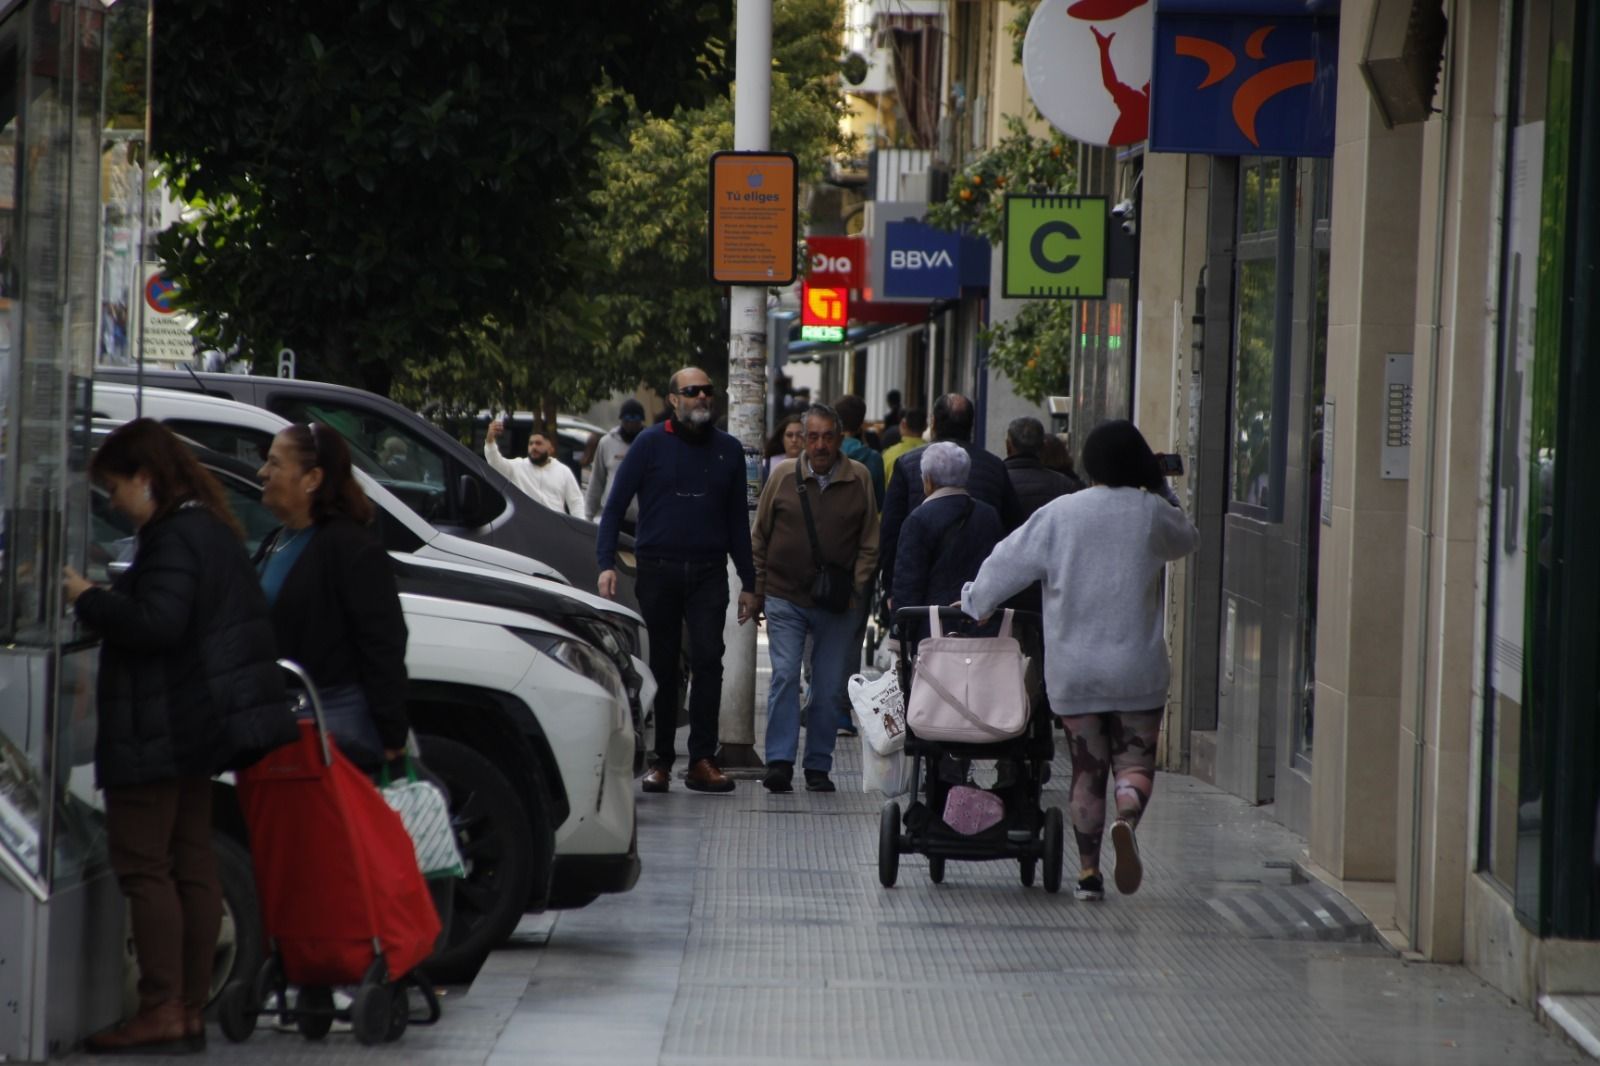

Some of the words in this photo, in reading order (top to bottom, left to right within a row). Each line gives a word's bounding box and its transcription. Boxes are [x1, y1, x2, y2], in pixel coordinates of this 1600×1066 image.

[743, 191, 779, 203] eliges
[1030, 220, 1082, 274] C
[891, 250, 953, 269] BBVA
